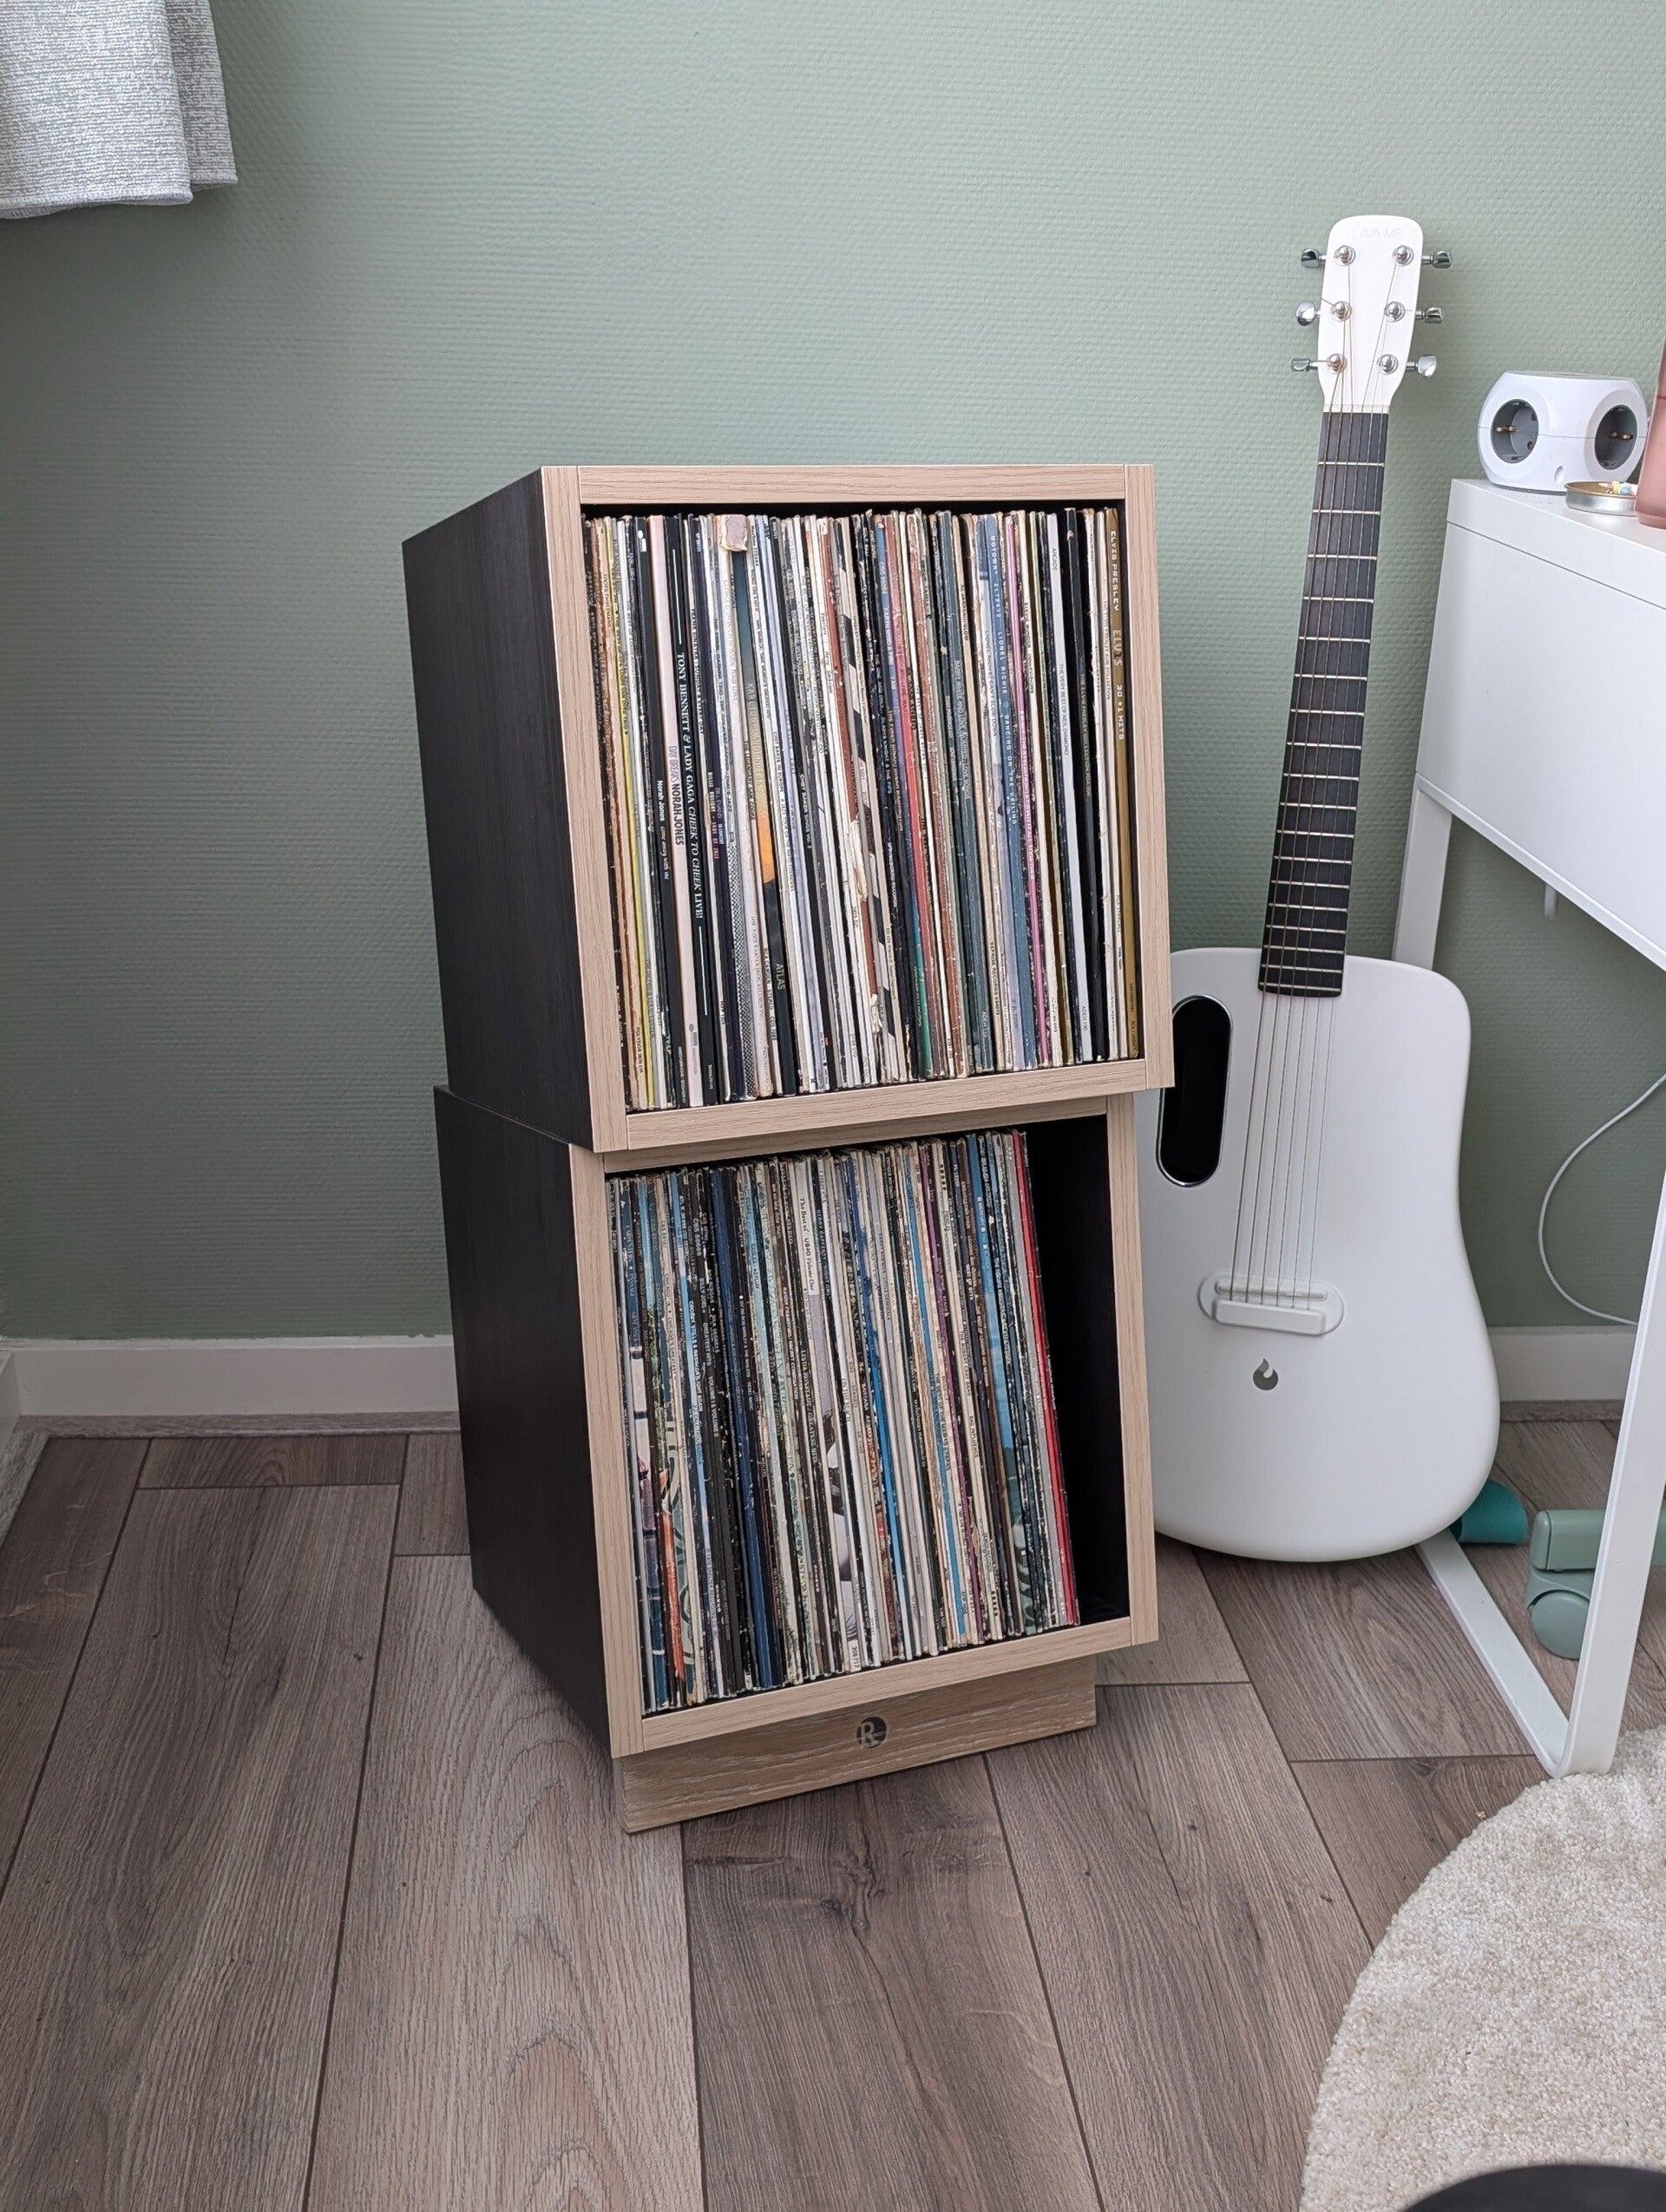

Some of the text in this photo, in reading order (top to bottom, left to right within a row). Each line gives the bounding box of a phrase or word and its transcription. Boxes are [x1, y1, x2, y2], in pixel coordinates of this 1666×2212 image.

[1353, 227, 1403, 239] LAVA ME
[1111, 563, 1119, 611] PRESLEY
[676, 651, 686, 681] TONY
[678, 684, 690, 732] BENNETT
[683, 744, 692, 771] LADY
[656, 780, 665, 800] Norah
[667, 744, 685, 846] DAY BREAKS NORAH JONES
[685, 775, 695, 804] GAGA
[657, 801, 666, 821] Jones
[686, 805, 698, 839] CHEEK
[691, 857, 701, 890] CHEEK
[693, 893, 703, 919] LIVE!
[775, 963, 785, 990] ATLAS
[805, 1256, 814, 1279] Volume
